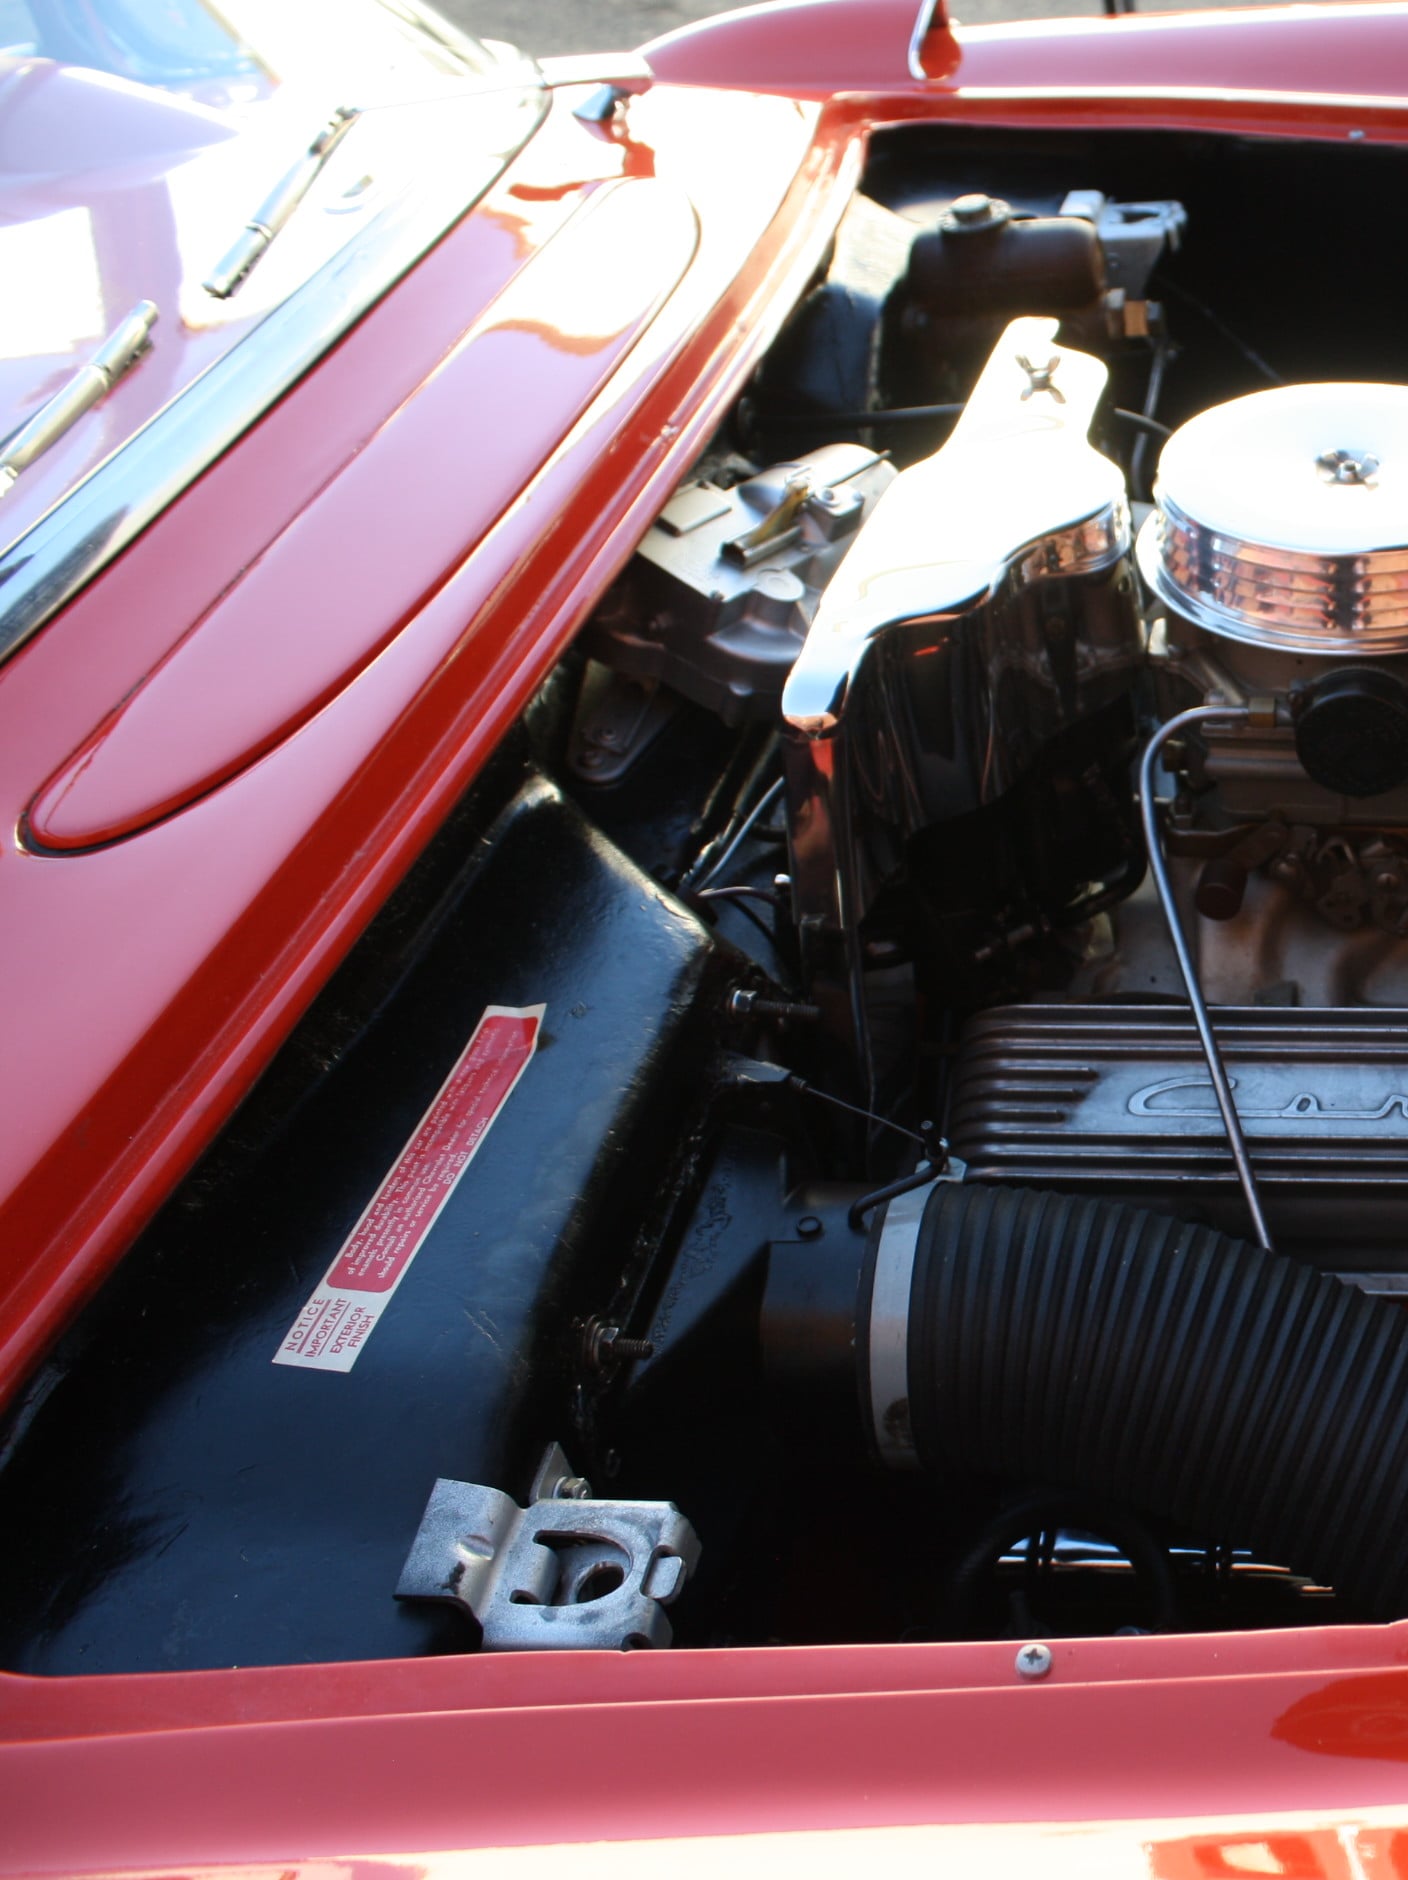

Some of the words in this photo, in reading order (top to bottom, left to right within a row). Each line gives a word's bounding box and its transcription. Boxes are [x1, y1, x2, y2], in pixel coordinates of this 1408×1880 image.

[443, 1171, 456, 1185] DO
[453, 1150, 468, 1167] NOT
[465, 1115, 488, 1147] DETACH
[344, 1237, 363, 1258] Body,
[358, 1217, 375, 1235] hood
[371, 1202, 385, 1215] and
[380, 1175, 401, 1200] fenders
[345, 1266, 356, 1275] of
[351, 1232, 378, 1265] improved
[395, 1179, 409, 1193] This
[355, 1247, 379, 1276] enamels
[374, 1215, 399, 1246] presently
[401, 1176, 421, 1204] common
[375, 1234, 397, 1261] Consult
[421, 1152, 446, 1185] Chevrolet
[441, 1129, 460, 1152] Dealer
[376, 1255, 396, 1278] should
[391, 1229, 412, 1254] repairs
[413, 1194, 432, 1217] service
[284, 1298, 325, 1350] NOTICE
[303, 1298, 347, 1357] IMPORTANT
[328, 1305, 366, 1353] EXTERIOR
[346, 1314, 374, 1347] FINISH
